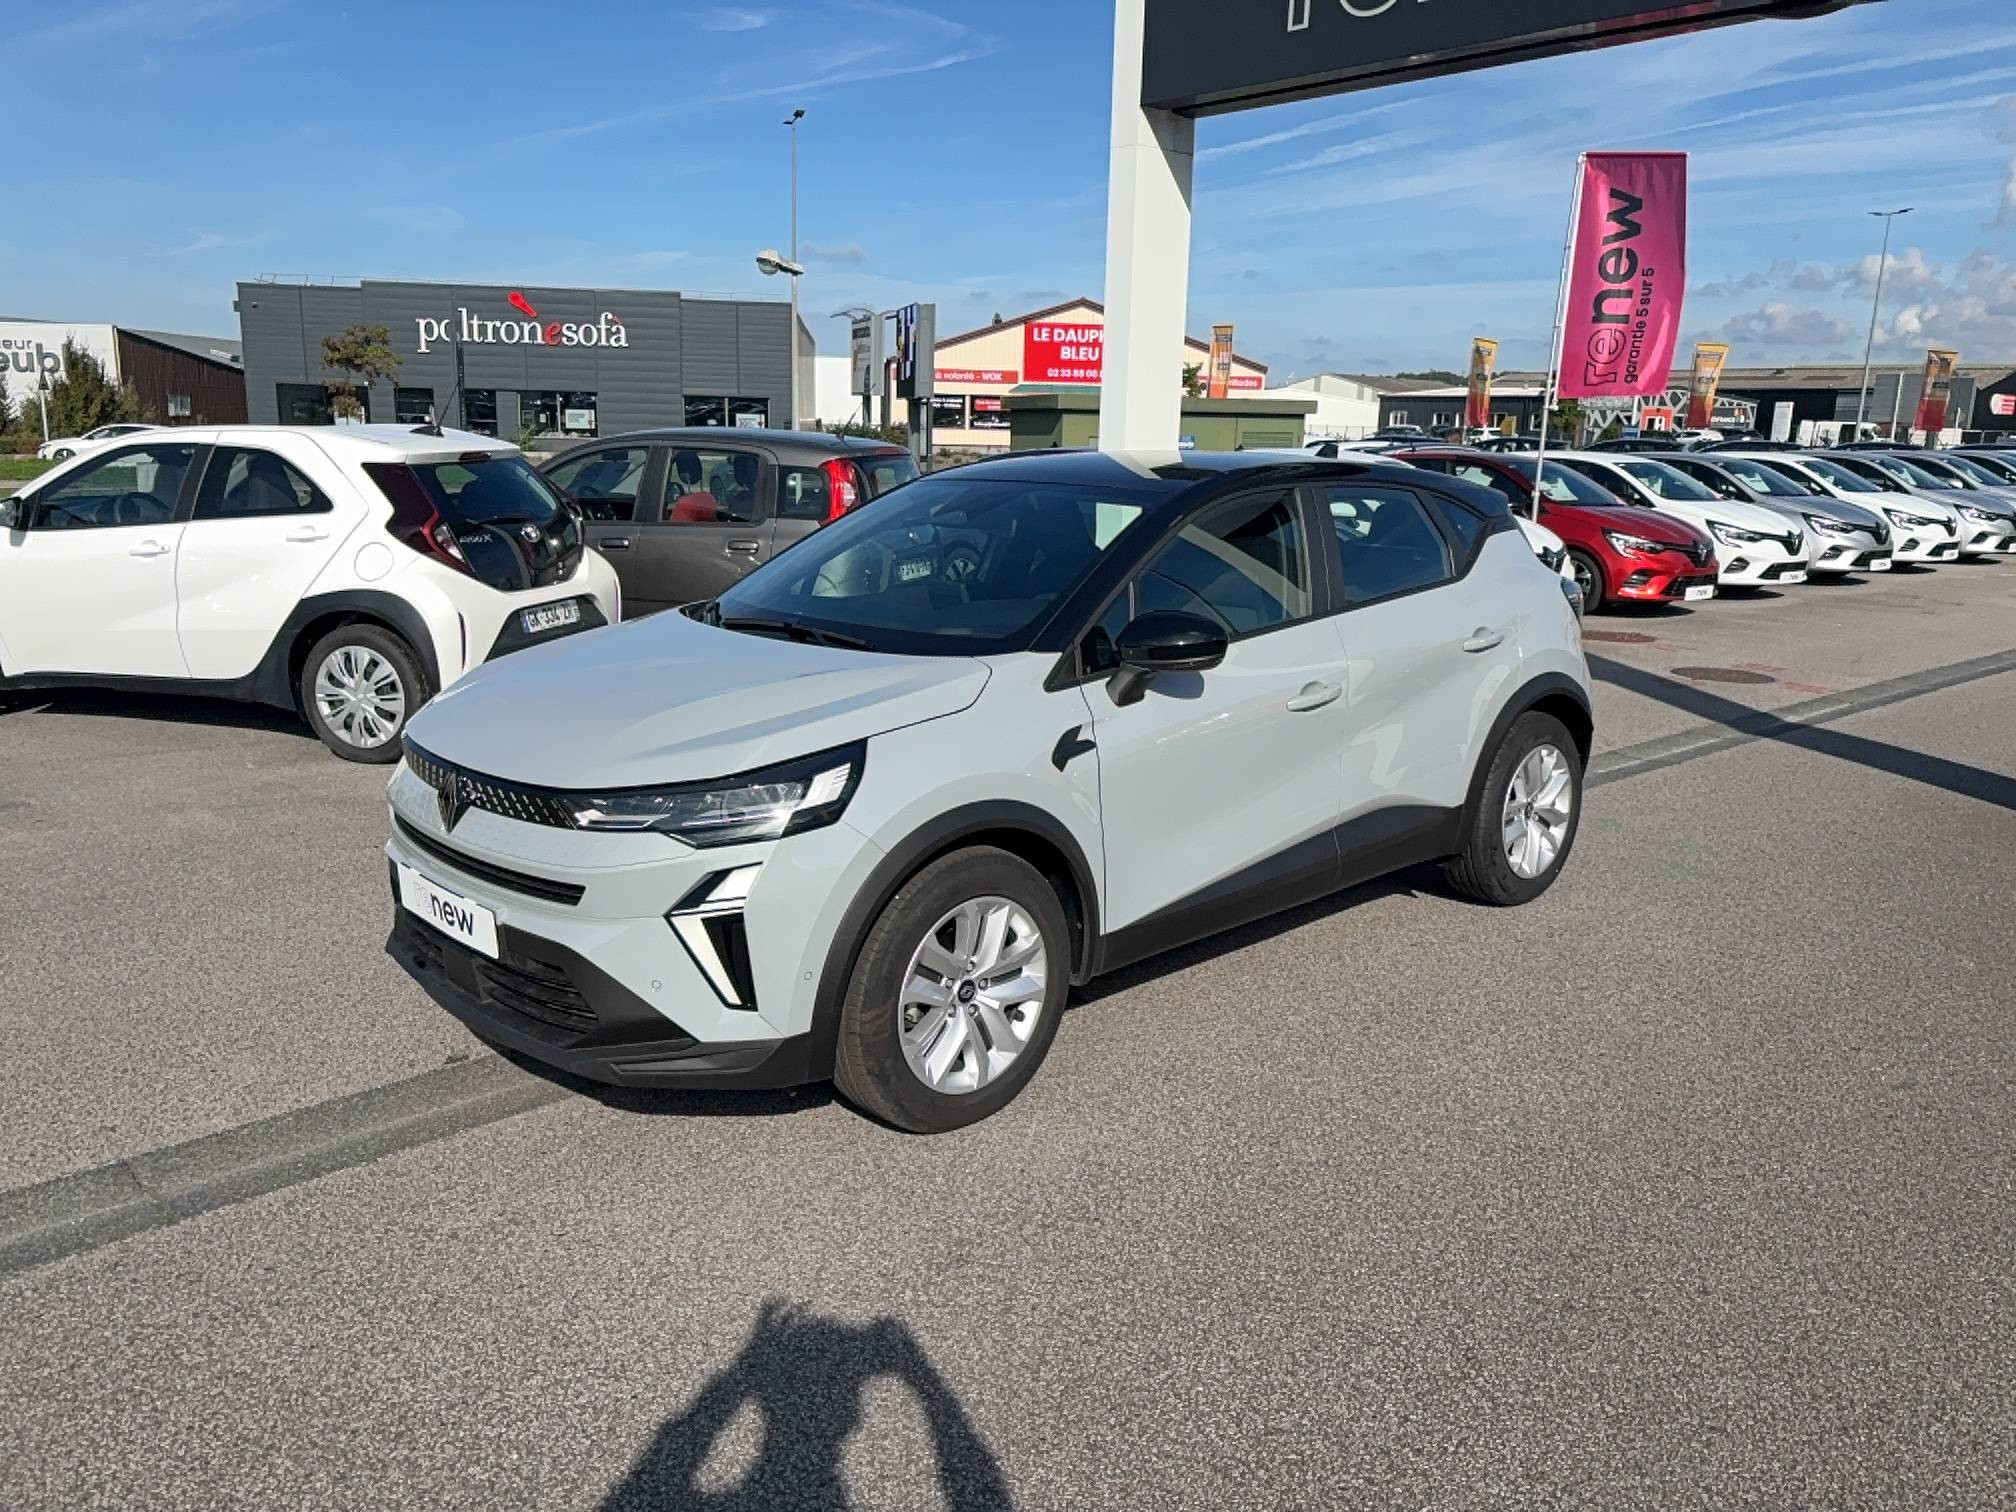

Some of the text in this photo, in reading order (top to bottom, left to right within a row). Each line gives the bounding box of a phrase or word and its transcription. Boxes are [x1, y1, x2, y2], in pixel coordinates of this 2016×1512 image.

[1584, 187, 1643, 387] renew
[1624, 267, 1655, 384] garantie 5 sur 5
[1032, 327, 1051, 342] LE
[0, 339, 33, 350] eur
[1059, 345, 1100, 361] BLEU
[981, 371, 1003, 381] WOK
